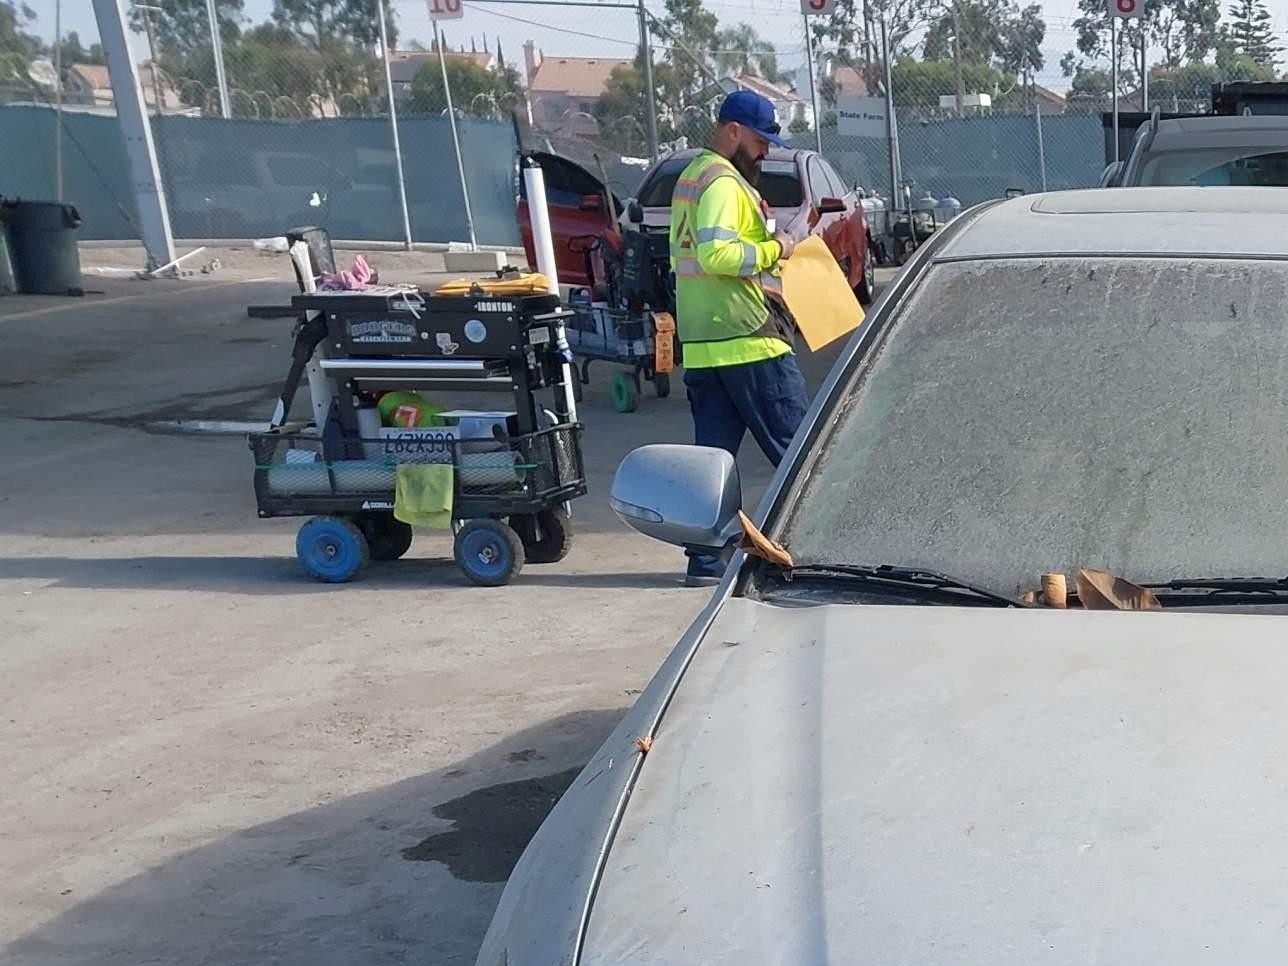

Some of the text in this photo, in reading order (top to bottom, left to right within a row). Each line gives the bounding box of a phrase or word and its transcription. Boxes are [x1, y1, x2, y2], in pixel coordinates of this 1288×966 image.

[840, 110, 885, 121] State Farm
[477, 301, 513, 312] IRONTON
